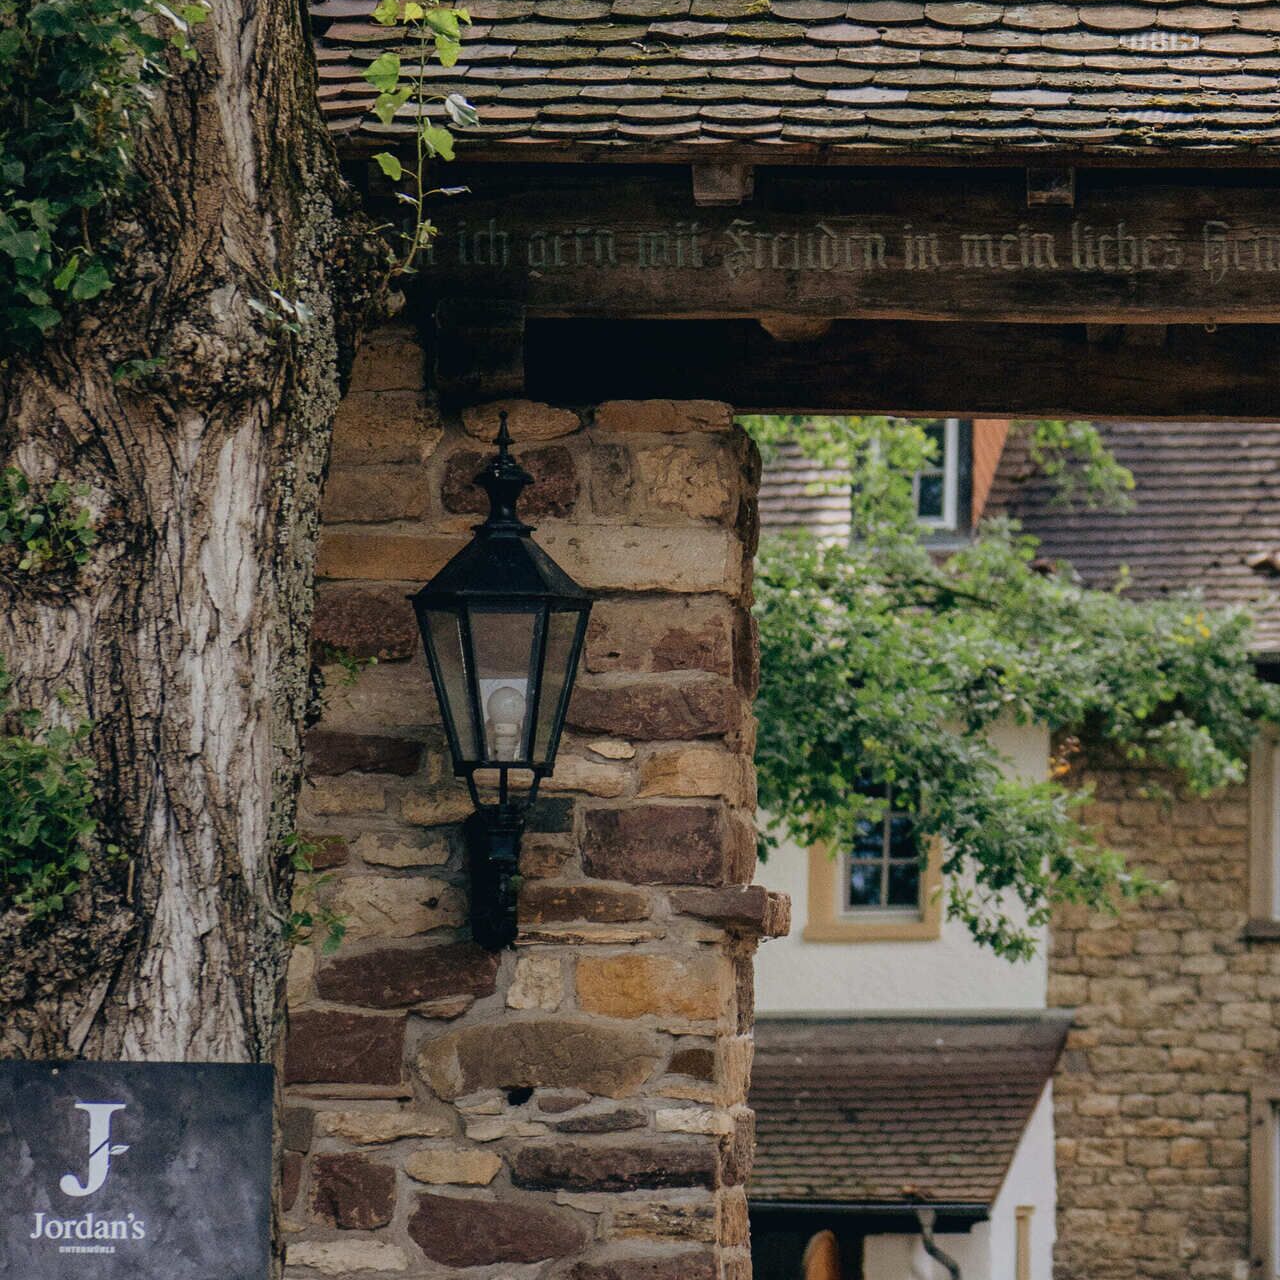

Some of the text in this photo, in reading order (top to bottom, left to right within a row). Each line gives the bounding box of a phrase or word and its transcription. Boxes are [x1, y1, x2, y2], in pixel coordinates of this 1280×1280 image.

[638, 221, 702, 268] mit
[903, 223, 941, 271] in
[960, 223, 1059, 271] mein
[1071, 218, 1184, 272] liebes
[59, 1102, 127, 1197] J
